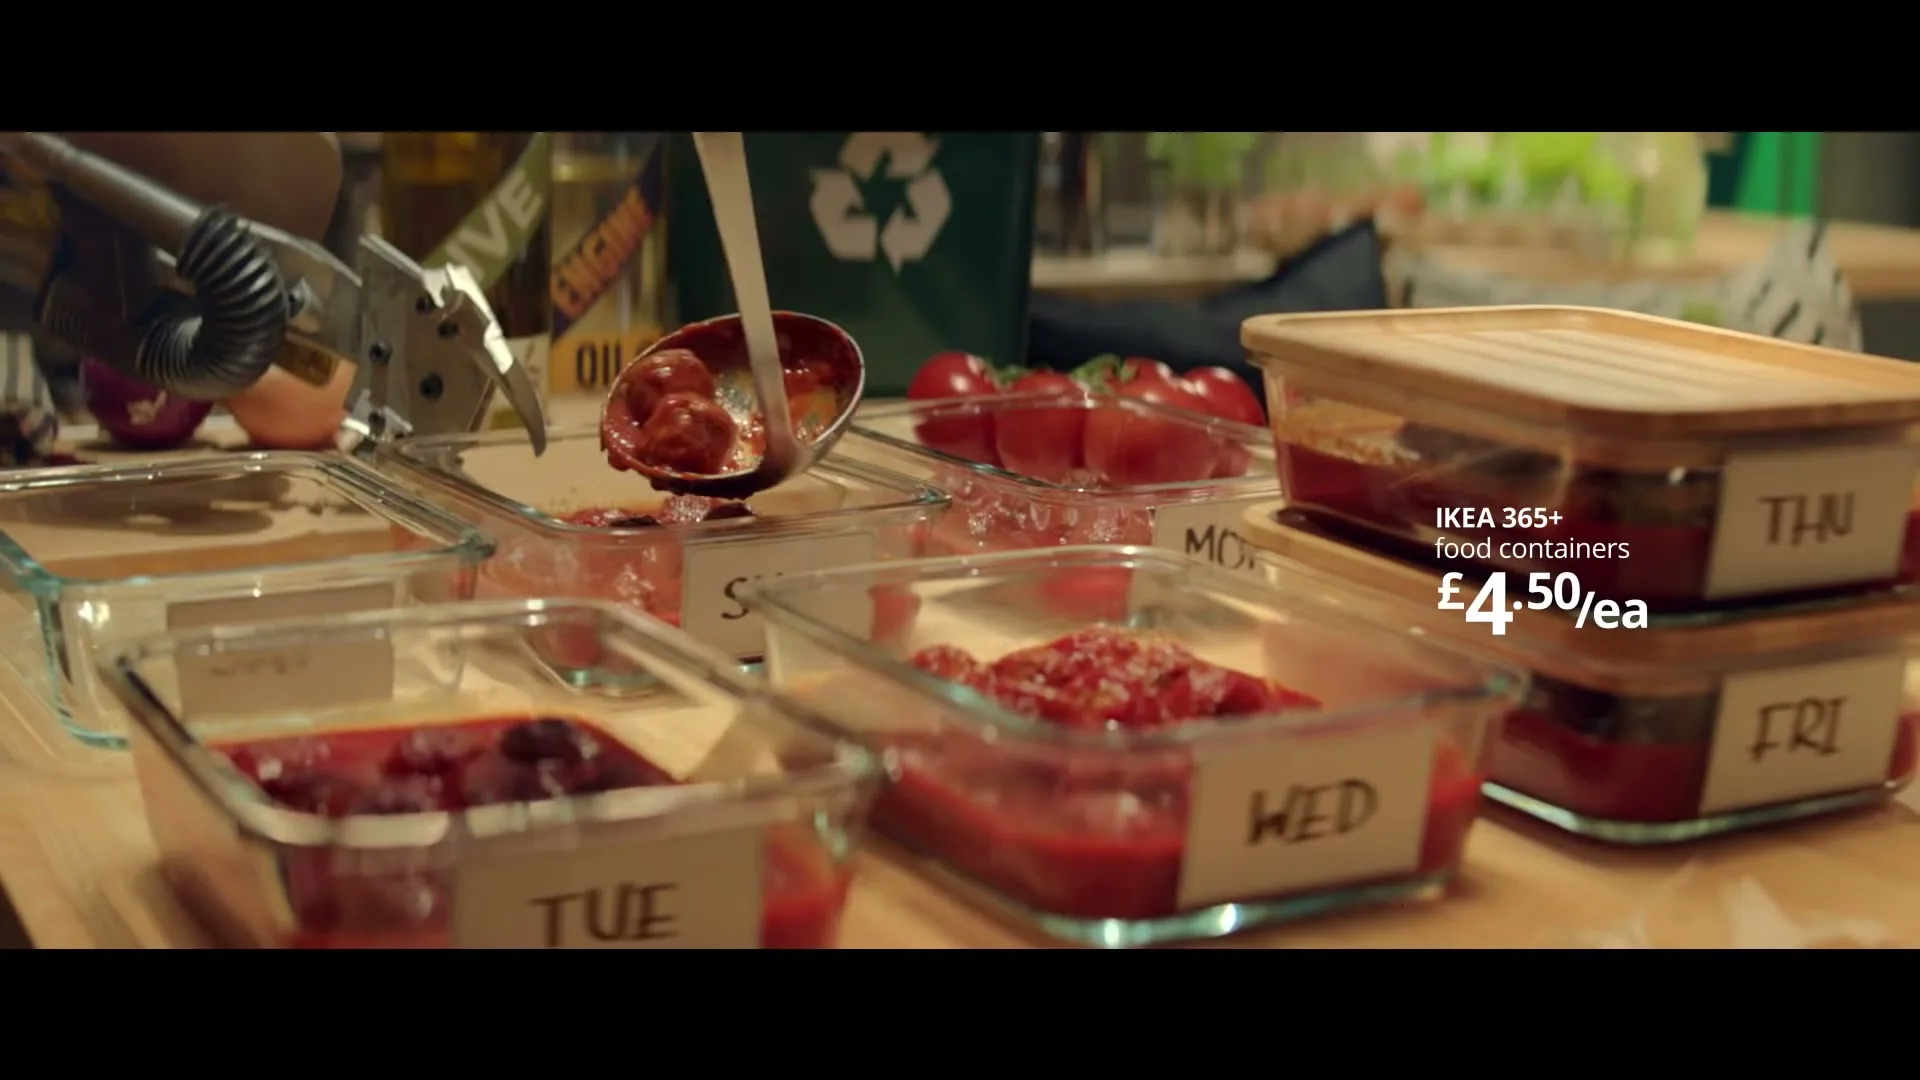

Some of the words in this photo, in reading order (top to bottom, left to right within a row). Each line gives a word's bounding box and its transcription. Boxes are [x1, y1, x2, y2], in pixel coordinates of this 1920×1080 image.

[444, 167, 543, 284] IVE
[1185, 524, 1255, 570] MO
[1758, 492, 1854, 546] THU
[1747, 696, 1846, 762] FRI
[1246, 776, 1380, 845] WED
[527, 881, 679, 948] TUE
